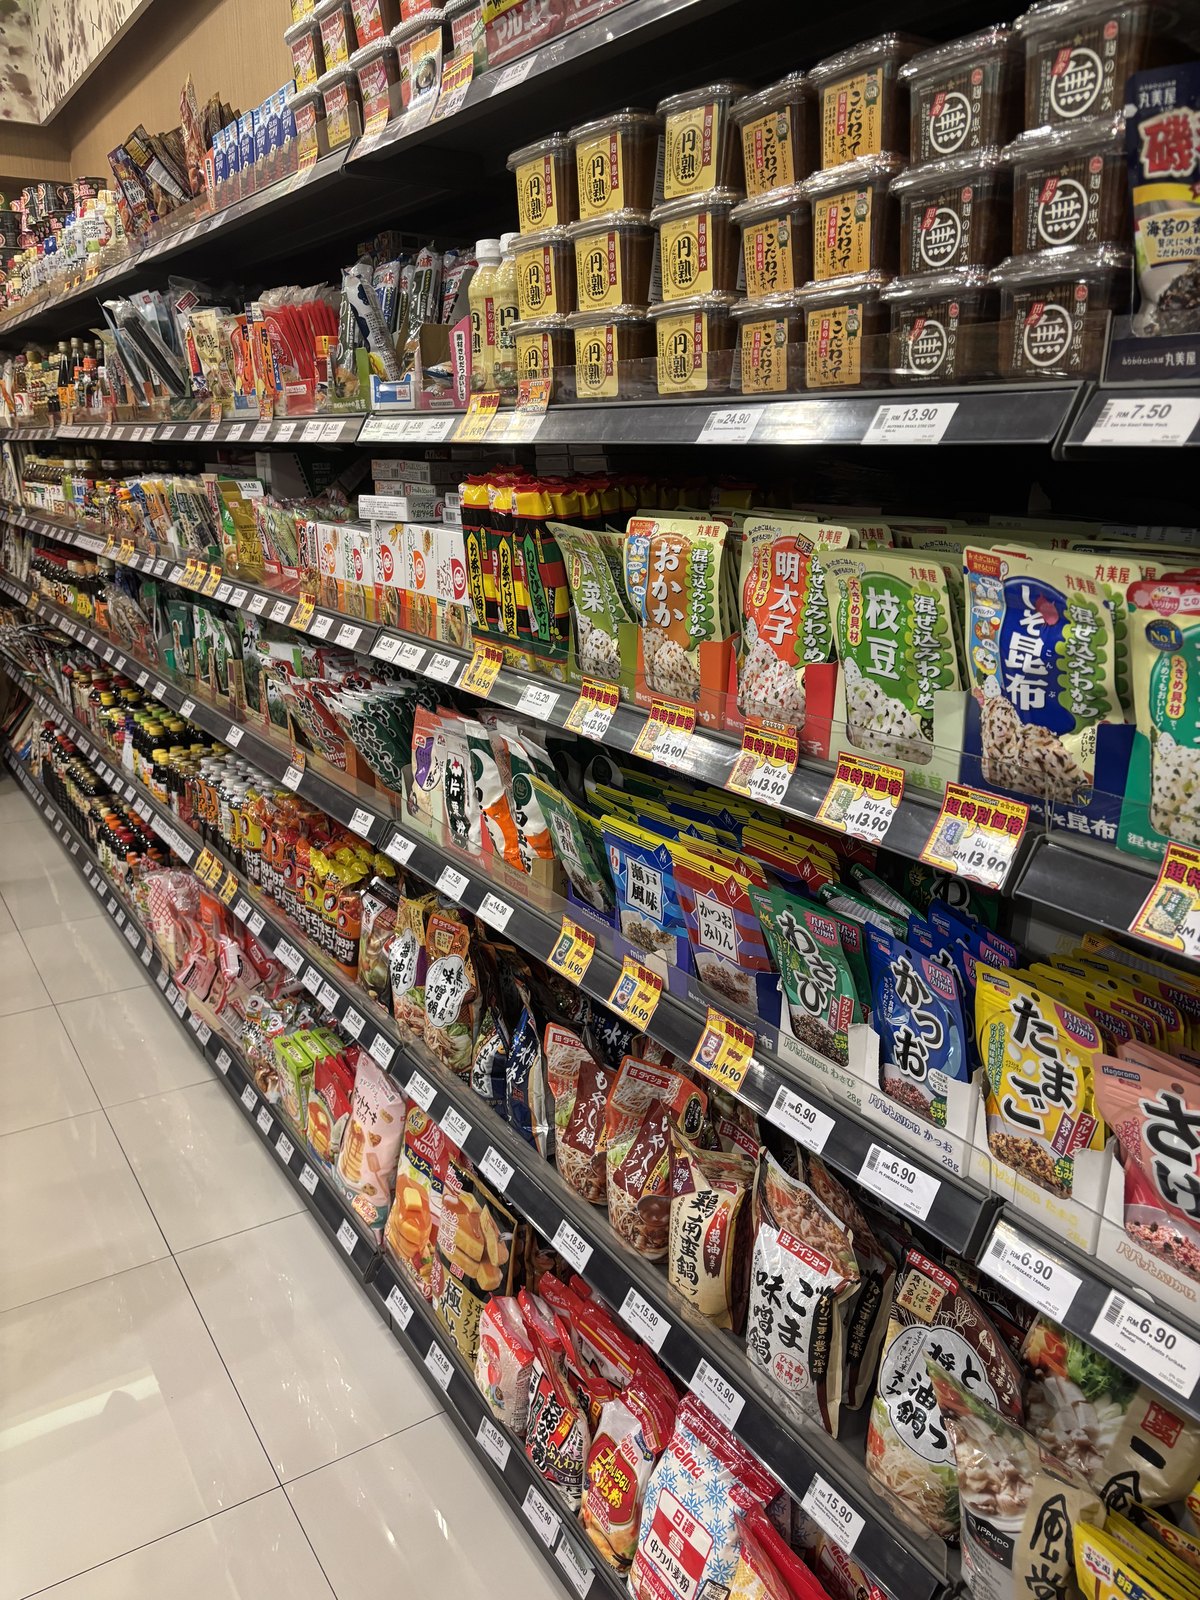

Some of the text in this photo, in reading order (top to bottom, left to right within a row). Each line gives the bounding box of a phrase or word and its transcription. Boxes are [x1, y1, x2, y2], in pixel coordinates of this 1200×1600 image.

[1057, 60, 1096, 107] 無
[1139, 88, 1176, 109] 丸美屋
[847, 91, 862, 155] こだわって
[935, 103, 966, 144] 無
[681, 130, 696, 180] 円熟
[764, 128, 777, 186] こだわって
[1144, 114, 1200, 173] 磯
[591, 156, 605, 202] 円熟
[1045, 190, 1081, 232] 無
[1087, 175, 1101, 241] 麹の恵み
[837, 206, 851, 269] こだわって
[926, 219, 955, 256] 無
[677, 236, 692, 284] 円熟
[765, 234, 778, 289] こだわって
[529, 265, 541, 306] 円熟
[913, 328, 942, 365] 無
[1031, 315, 1066, 354] 無
[673, 333, 687, 378] 円熟
[829, 320, 842, 379] こだわって
[1165, 351, 1196, 366] 丸美屋
[723, 413, 751, 425] 24.90
[901, 408, 938, 422] 13.90
[1130, 404, 1172, 419] 7.50
[697, 524, 720, 537] 丸美屋
[818, 530, 843, 544] 丸美屋
[651, 541, 685, 628] おかか
[754, 546, 771, 605] 大きめ具材
[909, 566, 938, 583] 丸美屋
[1065, 574, 1096, 595] 丸美屋
[1095, 564, 1131, 585] 丸美屋
[690, 548, 709, 637] 混ぜ込みわかめ
[763, 552, 803, 645] 明太子
[849, 579, 861, 643] 大きめ具材
[866, 587, 900, 680] 枝豆
[1005, 585, 1048, 711] しそ昆布
[913, 594, 941, 711] 混ぜ込みわかめ
[1065, 605, 1098, 718] 混ぜ込みわかめ
[533, 691, 550, 703] 15.20
[1169, 657, 1185, 716] 大きめ具材
[588, 719, 607, 733] 13.90
[661, 741, 682, 758] 13.90
[743, 735, 797, 764] 超特別価格
[763, 766, 776, 776] BUY
[837, 764, 902, 796] 超特別価格
[757, 778, 785, 797] 13.90
[843, 811, 889, 832] RM 13.90
[863, 800, 879, 811] BUY
[880, 805, 885, 814] 2
[944, 797, 1023, 834] 超特別価格
[975, 838, 992, 851] BUY
[631, 862, 658, 886] 瀬戸
[952, 850, 1008, 873] RM 13.90
[630, 885, 659, 912] 風味
[699, 902, 732, 931] かつお
[1174, 924, 1195, 938] RM
[704, 923, 733, 951] みりん
[567, 961, 583, 976] 11.90
[776, 911, 837, 1017] わさび
[631, 1004, 649, 1022] 11.90
[892, 957, 943, 1080] かつお
[1066, 1022, 1095, 1042] ふりかけ
[720, 1063, 742, 1082] 11.90
[1002, 995, 1076, 1131] たまご
[1103, 1066, 1140, 1081] Hagoromo
[419, 1080, 430, 1095] 15.90
[638, 1070, 670, 1088] ダイショー
[454, 1116, 466, 1132] 17.50
[572, 1102, 585, 1128] スープ
[794, 1102, 817, 1124] 6.90
[923, 1129, 953, 1153] かつお
[494, 1157, 508, 1175] 15.90
[625, 1143, 644, 1169] スープ
[941, 1154, 960, 1173] 28g
[881, 1161, 916, 1185] RM 6.90
[569, 1234, 586, 1254] 18.50
[677, 1189, 719, 1285] 鶏南蛮鍋
[789, 1238, 829, 1276] ダイショー
[1009, 1250, 1053, 1281] RM 6.90
[673, 1275, 698, 1297] スープ
[901, 1274, 920, 1304] 食べる鍋
[921, 1259, 958, 1290] ダイショー
[912, 1280, 929, 1309] いっぱい
[924, 1287, 941, 1313] 野菜を
[640, 1304, 659, 1326] 15.90
[750, 1269, 785, 1365] 味噌鍋
[777, 1278, 820, 1353] ごま
[1126, 1316, 1177, 1350] RM 6.90
[713, 1377, 735, 1403] 15.90
[537, 1500, 552, 1526] 22.90
[818, 1489, 853, 1523] RM 15.90
[672, 1509, 697, 1538] 日清
[649, 1538, 691, 1594] 中力小麦粉
